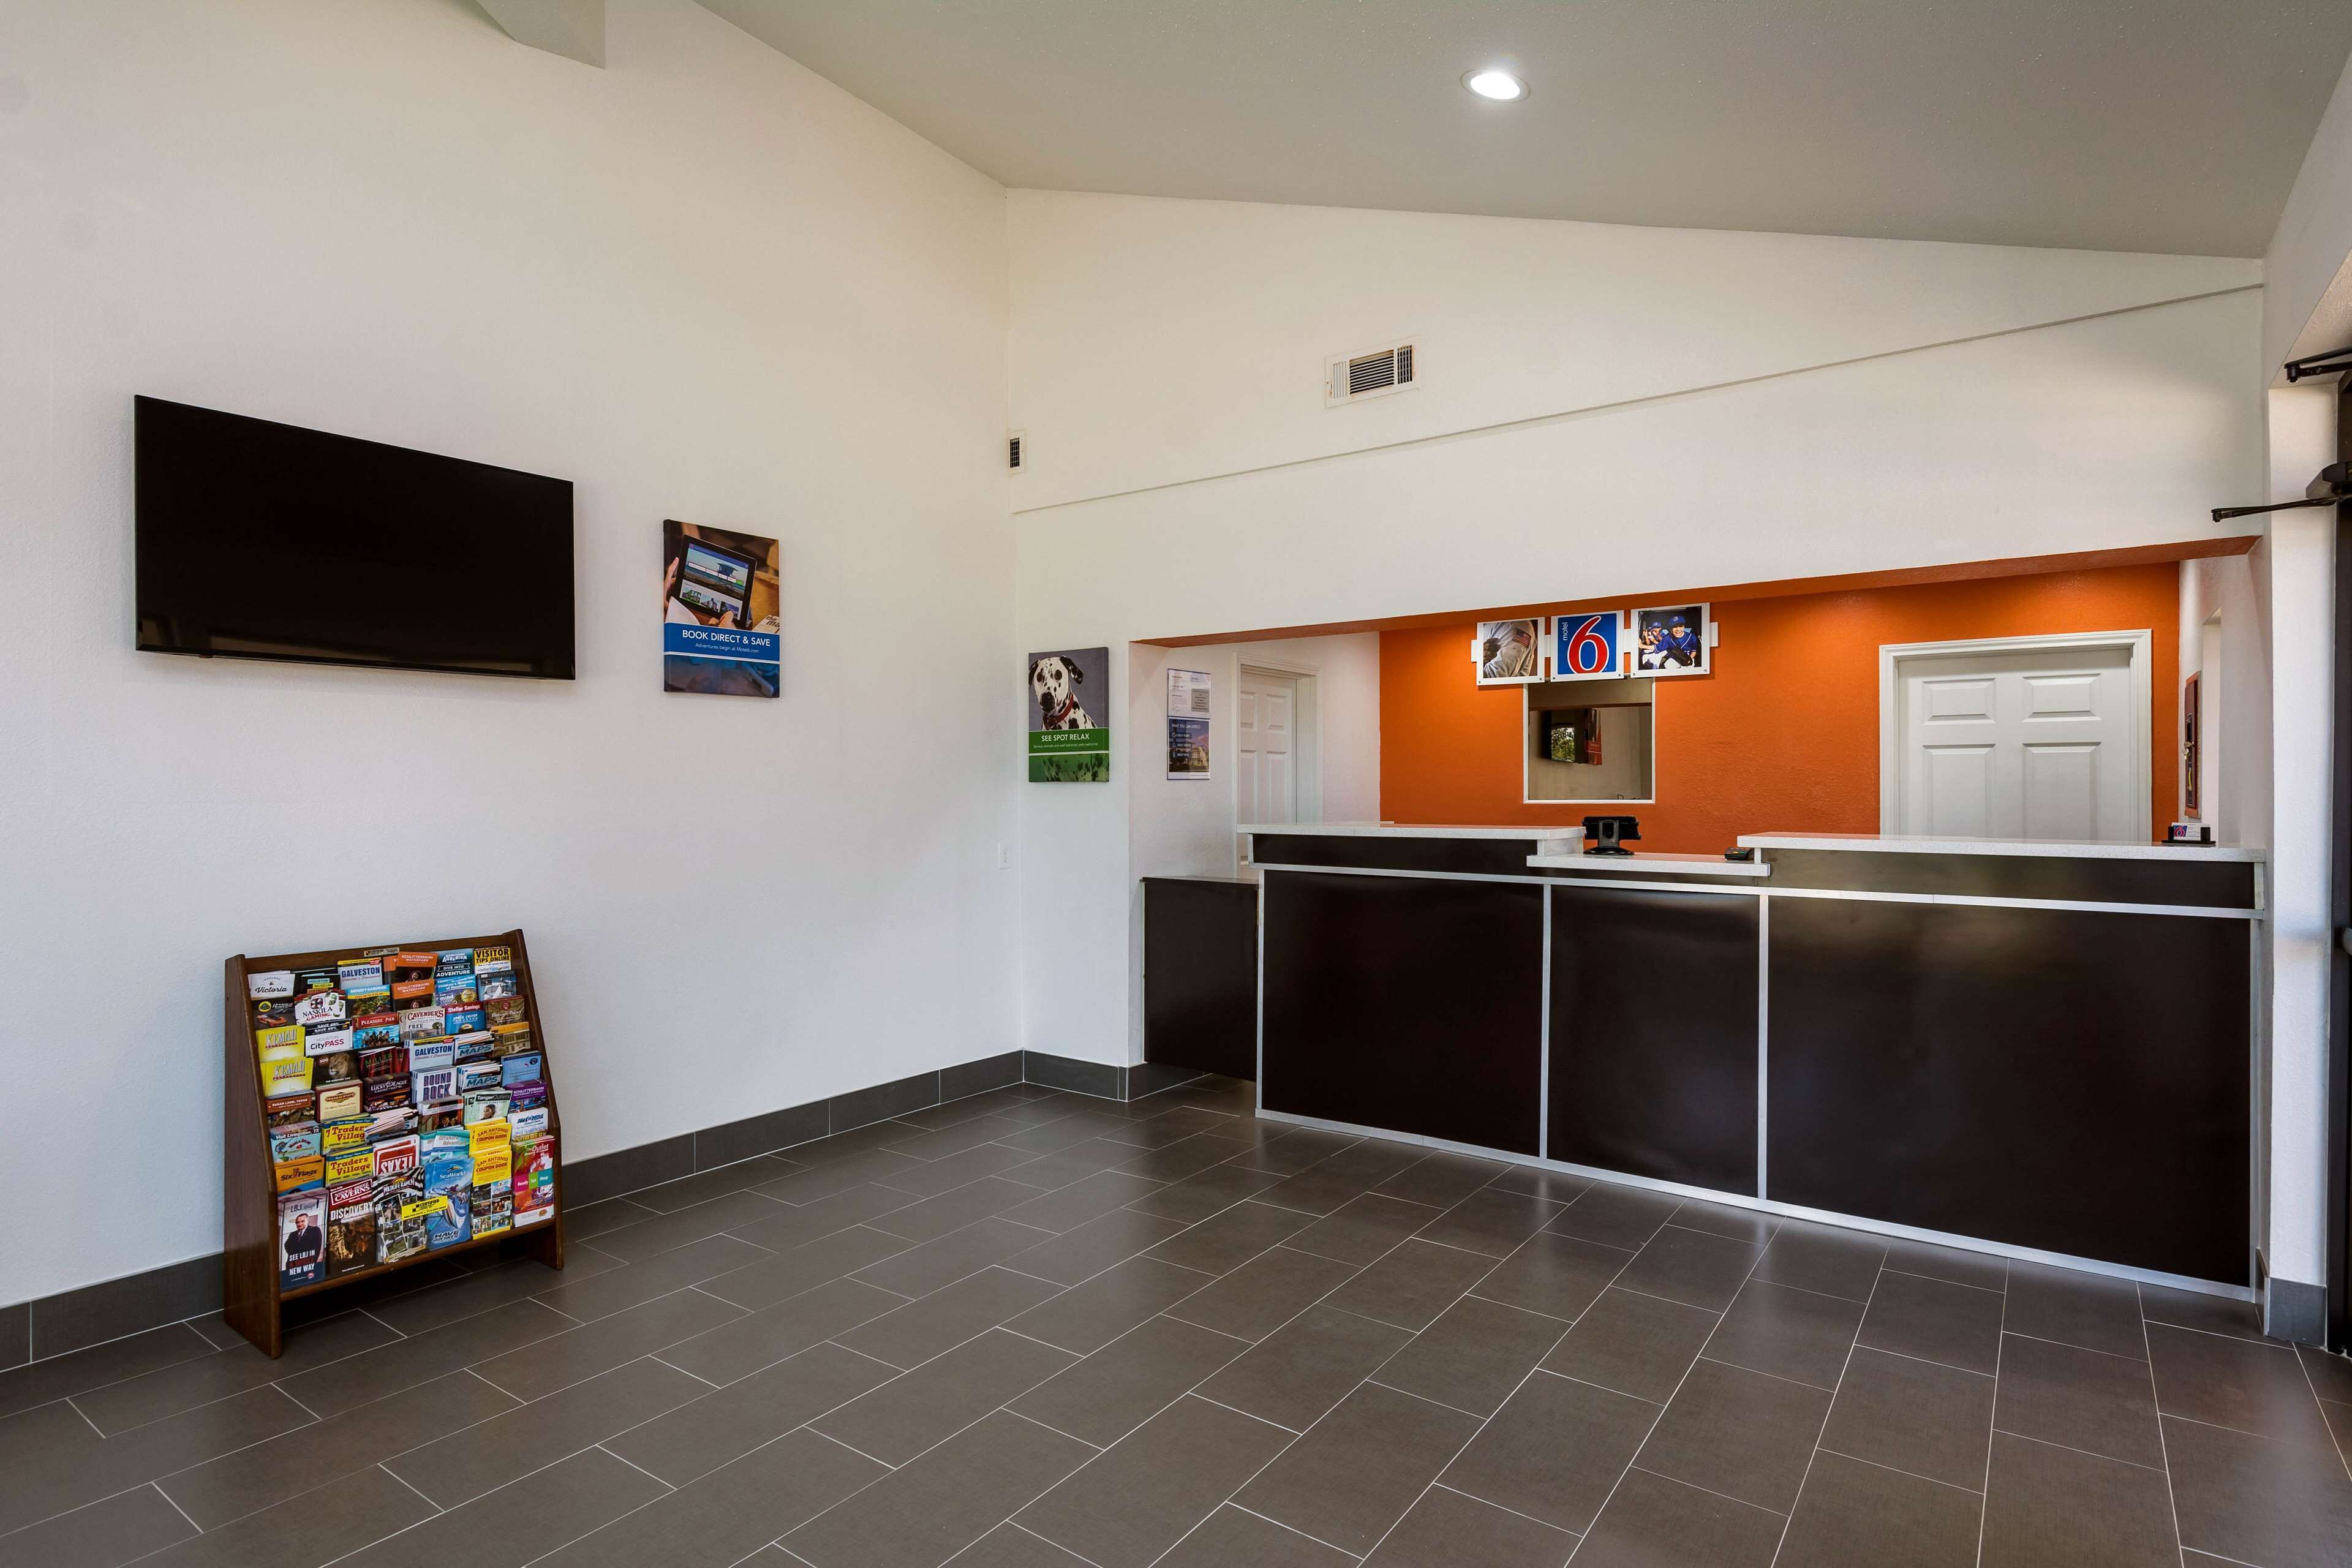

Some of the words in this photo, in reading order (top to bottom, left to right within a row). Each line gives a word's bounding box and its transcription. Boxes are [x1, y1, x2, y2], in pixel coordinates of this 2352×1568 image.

[682, 630, 708, 640] BOOK
[711, 633, 741, 643] DIRECT
[751, 637, 771, 647] SAVE
[1567, 615, 1610, 674] 6
[475, 949, 509, 959] VISITOR
[342, 967, 380, 978] GALVESTON
[302, 1006, 333, 1018] NASKILA
[306, 1012, 330, 1022] GAMING
[407, 1010, 444, 1021] CAVENDER'S
[266, 1029, 297, 1049] KEMAH
[311, 1039, 344, 1050] CityPASS
[415, 1046, 452, 1057] GALVESTON
[459, 1045, 492, 1057] MAPS
[365, 1053, 393, 1066] MILLER
[274, 1060, 306, 1079] KEMAH
[424, 1072, 451, 1087] ROUND
[467, 1076, 498, 1087] MAPS
[423, 1083, 451, 1101] ROCK
[337, 1132, 366, 1142] Villag
[330, 1156, 369, 1170] Traders
[380, 1158, 413, 1175] TEXAS
[336, 1164, 371, 1176] Village
[439, 1170, 466, 1179] SeaWorld
[383, 1183, 401, 1194] WILDLIFE
[400, 1178, 415, 1187] RANCH
[334, 1186, 370, 1202] CAVERNS
[291, 1204, 302, 1213] LBJ
[331, 1202, 374, 1221] DISCOVERY
[289, 1267, 302, 1276] NEW
[303, 1263, 315, 1272] WAY
